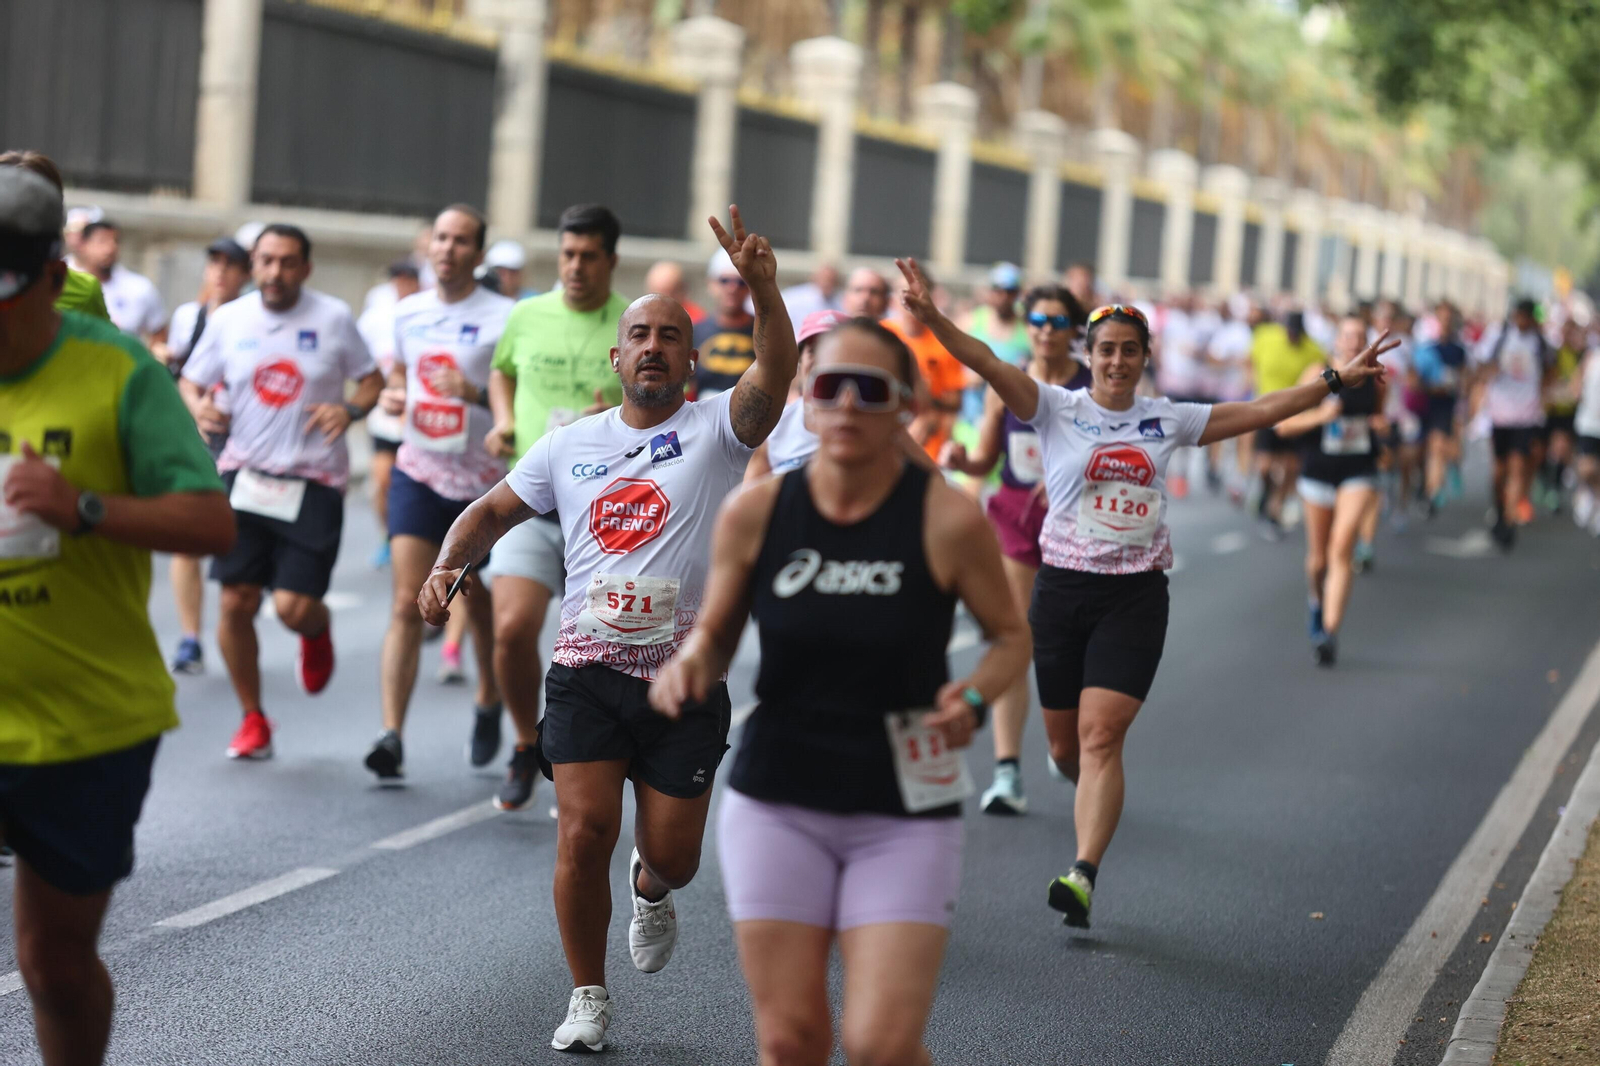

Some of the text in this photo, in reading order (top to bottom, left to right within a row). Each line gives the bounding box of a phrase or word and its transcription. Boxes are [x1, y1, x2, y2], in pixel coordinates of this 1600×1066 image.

[651, 443, 677, 460] AXA
[652, 457, 685, 471] fundación
[1100, 455, 1148, 479] PONLE
[601, 501, 659, 517] PONLE
[1094, 495, 1149, 517] 1120
[600, 517, 656, 533] FRENO
[813, 559, 905, 596] asics
[606, 592, 653, 614] 571
